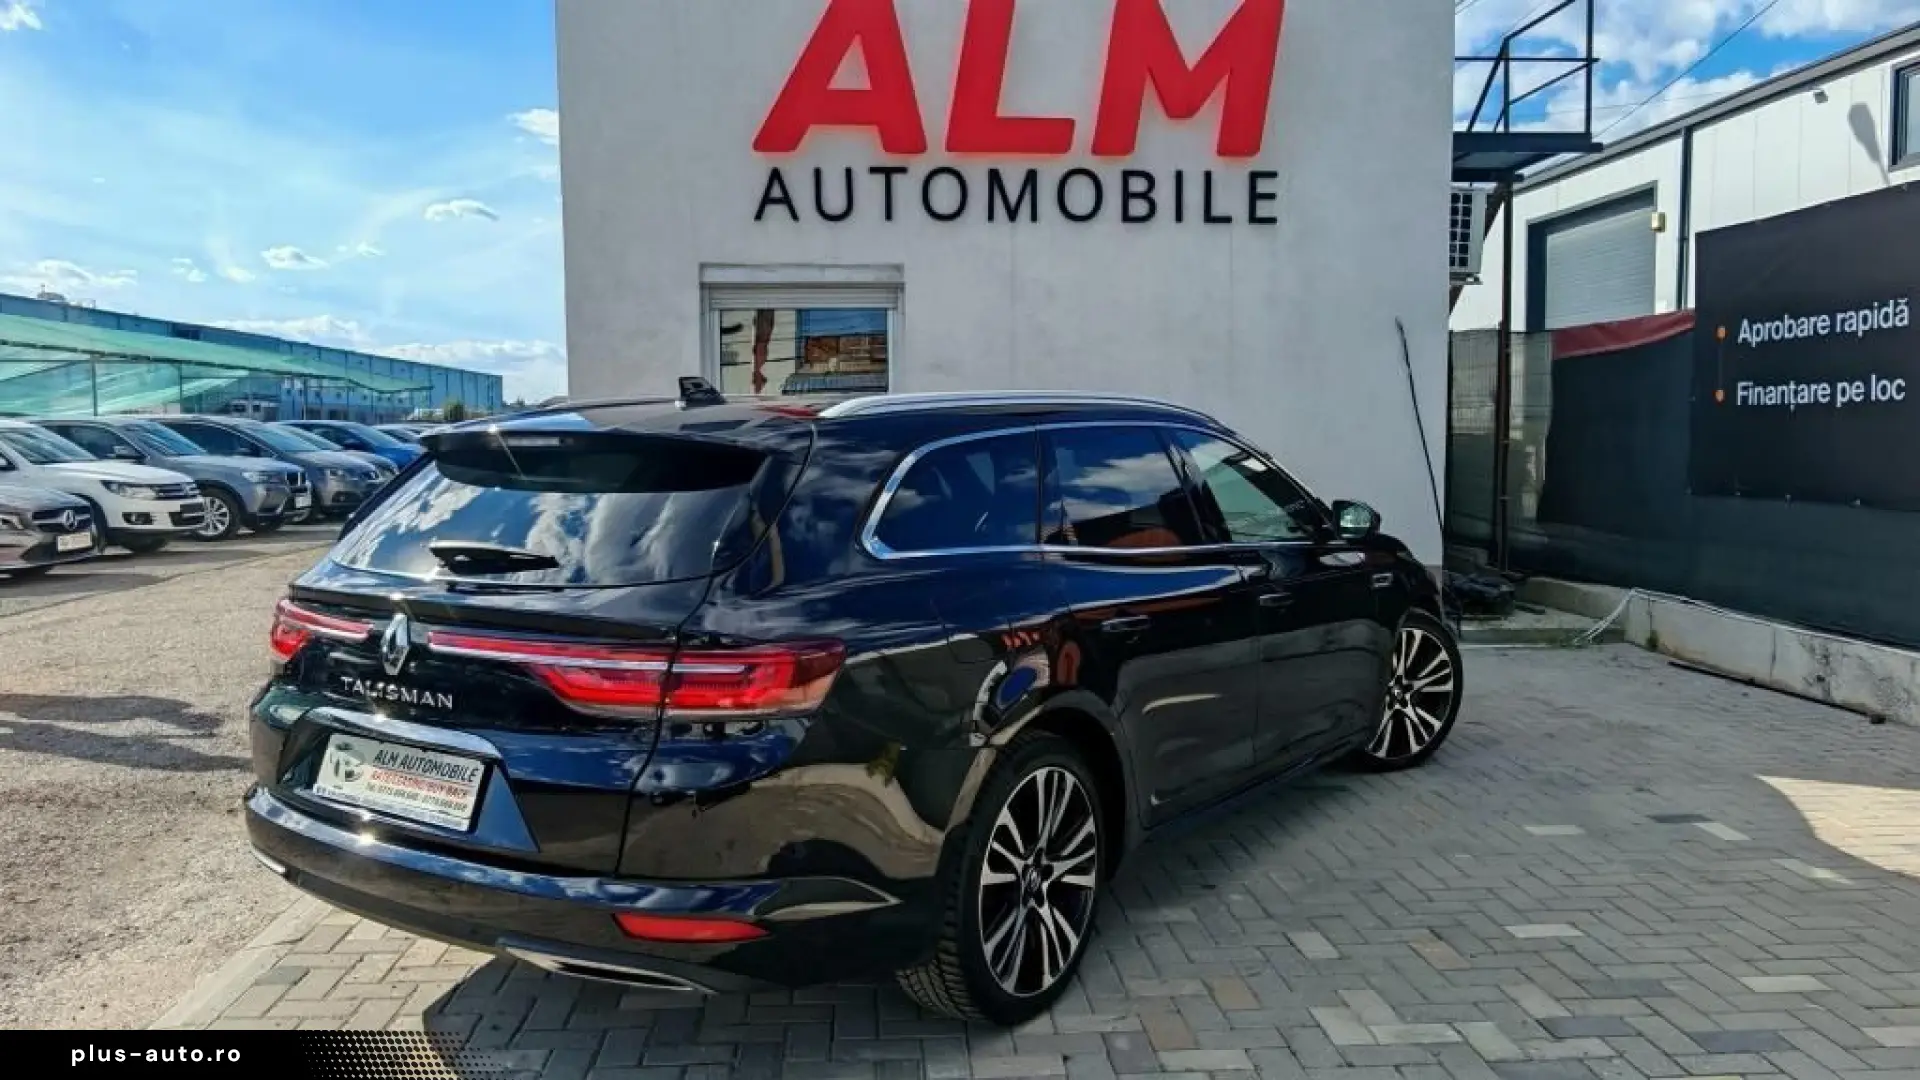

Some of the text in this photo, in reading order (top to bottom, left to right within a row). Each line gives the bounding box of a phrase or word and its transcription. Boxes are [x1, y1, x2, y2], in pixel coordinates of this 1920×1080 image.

[752, 0, 1285, 157] ALM
[753, 166, 1279, 224] AUTOMOBILE
[1737, 297, 1910, 348] Aprobare rapidă
[1736, 373, 1906, 413] Finanțare pe loc
[340, 676, 453, 710] TALISMAN
[374, 749, 479, 782] ALM AUTOMOBILE
